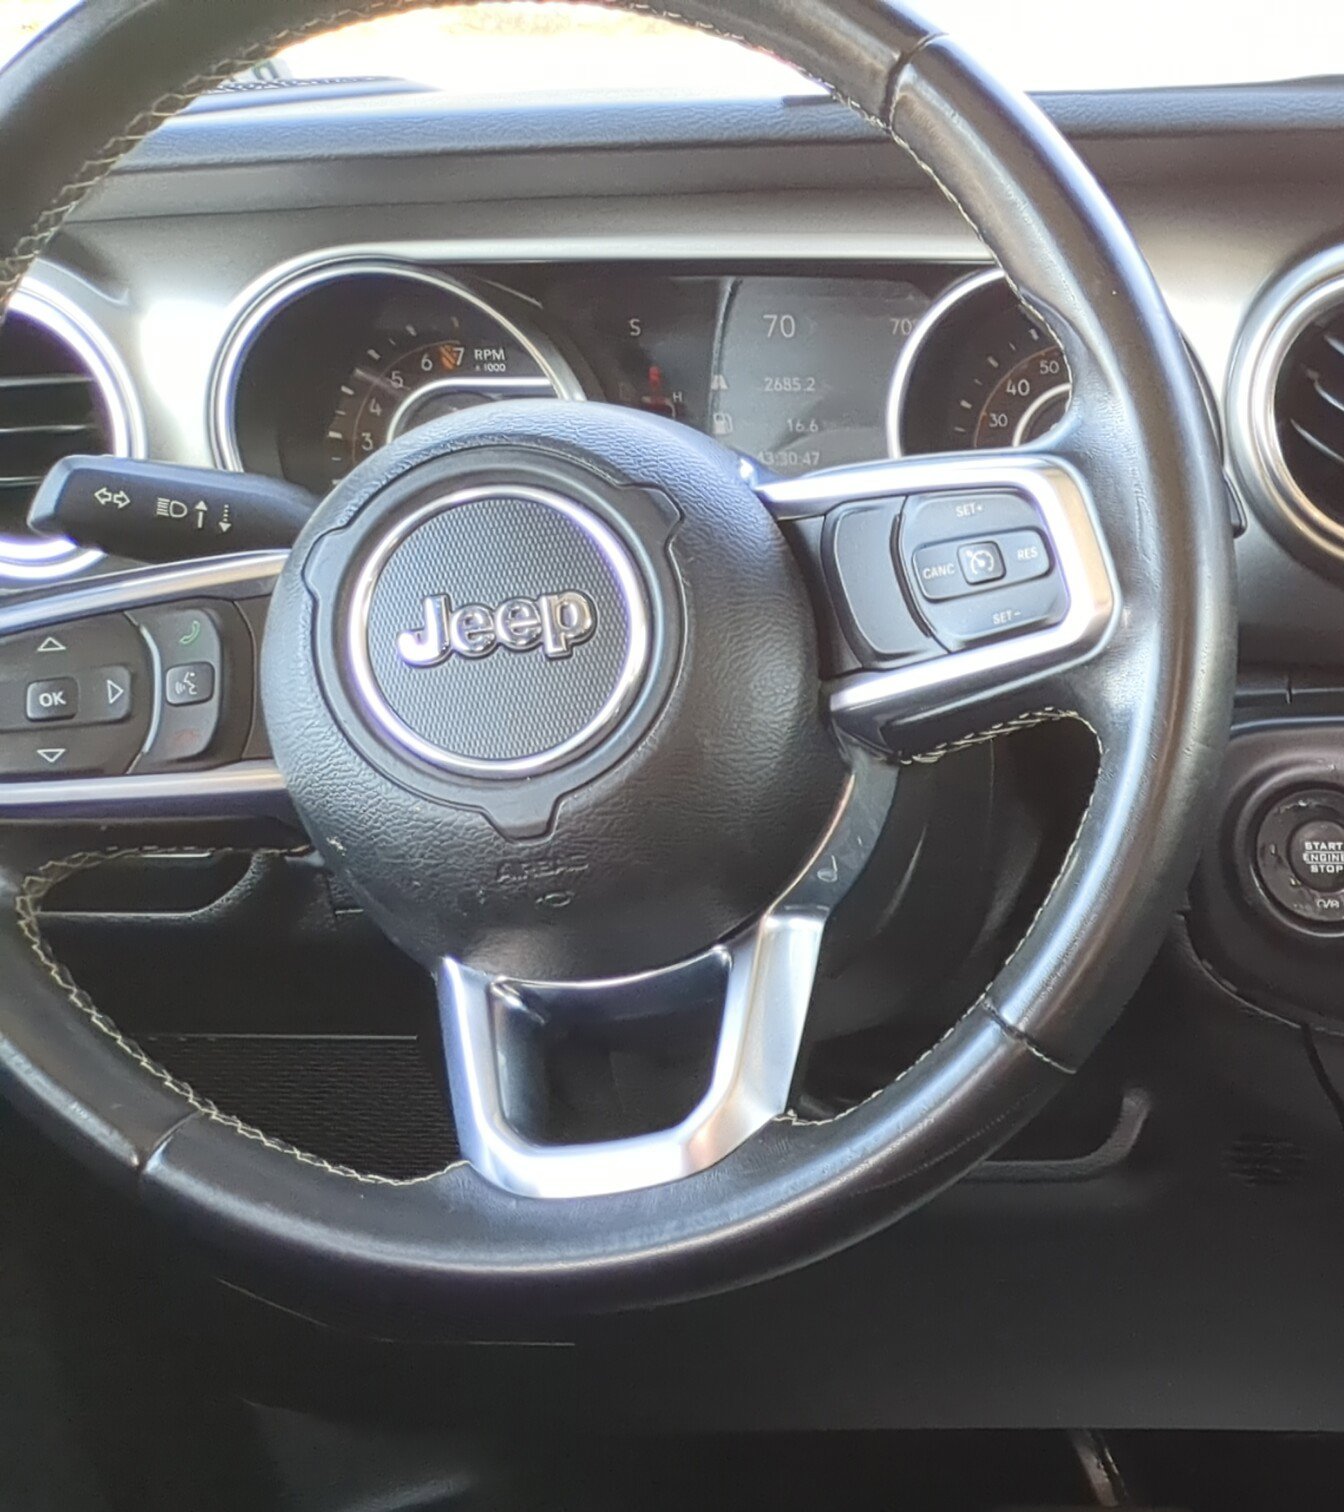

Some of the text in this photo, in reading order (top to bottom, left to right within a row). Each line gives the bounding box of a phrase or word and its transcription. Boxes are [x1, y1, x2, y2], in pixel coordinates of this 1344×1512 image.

[629, 318, 641, 336] S
[763, 314, 796, 338] 70
[421, 354, 433, 371] 6
[453, 347, 465, 366] 7
[474, 350, 506, 361] RPM
[1040, 360, 1059, 374] 50
[391, 370, 404, 388] 5
[764, 377, 816, 392] 2685.2
[1006, 379, 1031, 396] 40
[673, 392, 682, 402] H
[369, 398, 382, 416] 4
[787, 419, 818, 433] 16.6
[989, 413, 1009, 427] 30
[361, 432, 373, 451] 3
[1017, 547, 1038, 560] RES
[922, 563, 955, 580] CANC
[397, 588, 598, 668] Jeep
[39, 691, 66, 707] OK
[1304, 842, 1344, 851] START
[1310, 865, 1344, 873] STOP
